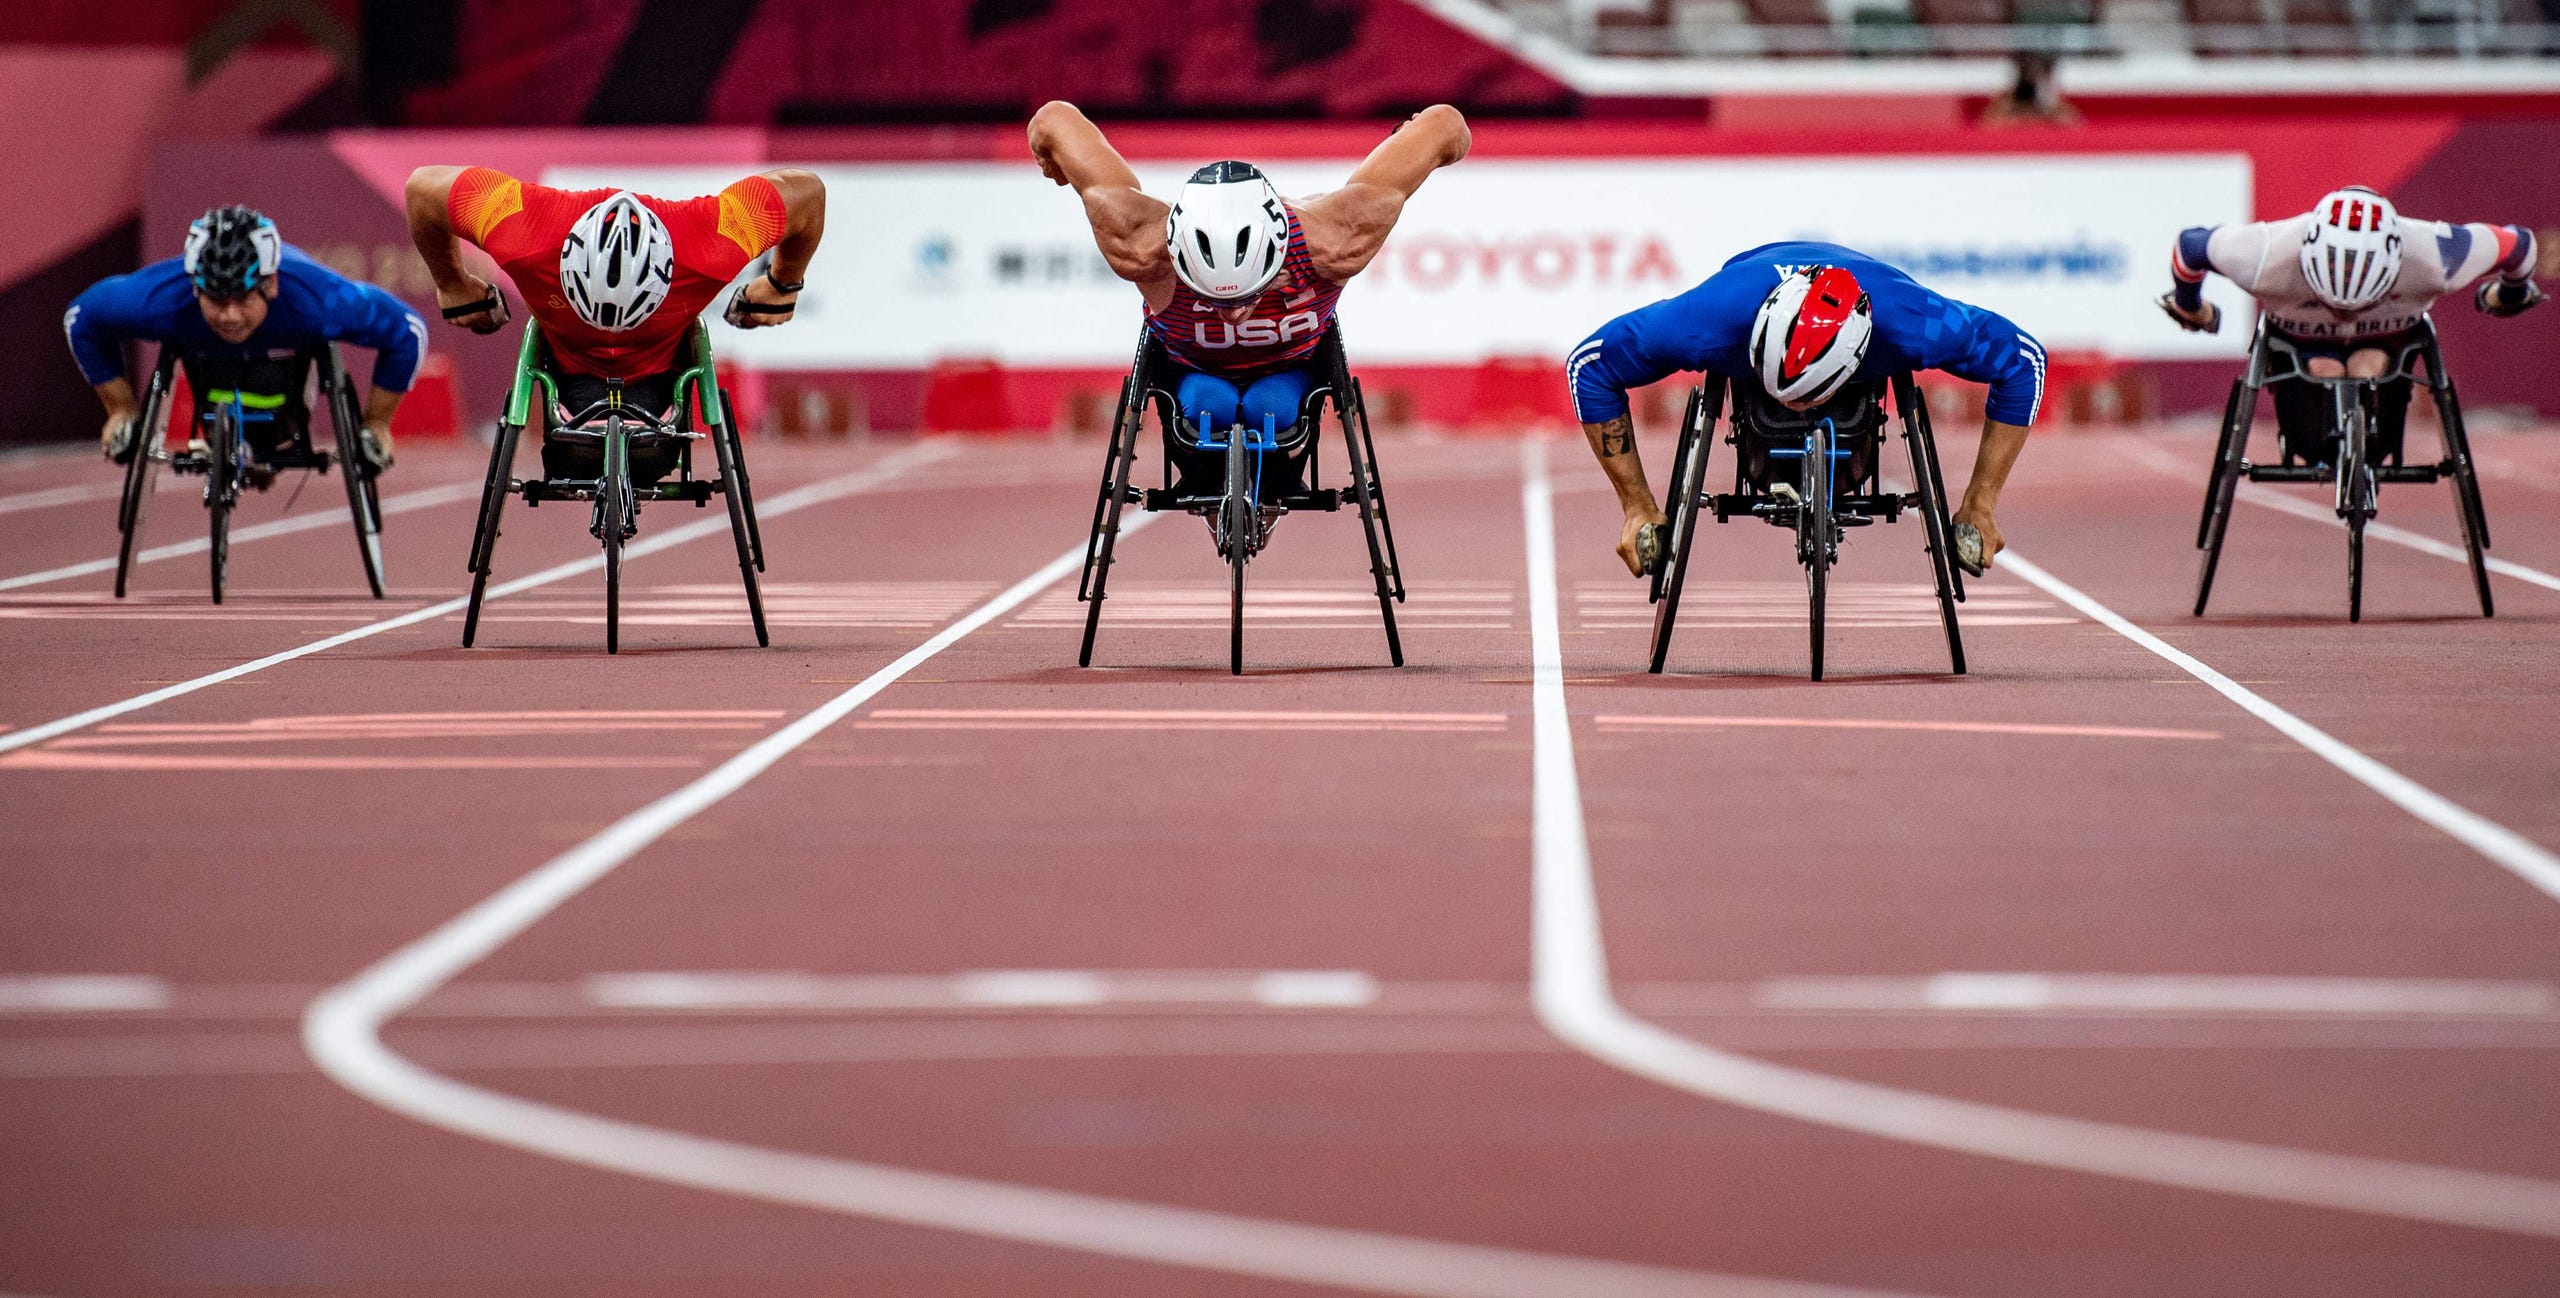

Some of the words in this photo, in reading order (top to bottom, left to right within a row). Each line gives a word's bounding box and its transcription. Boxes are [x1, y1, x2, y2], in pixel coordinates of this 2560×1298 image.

[1167, 203, 1183, 246] 5
[1262, 198, 1288, 241] 5
[262, 233, 277, 268] 7
[1215, 284, 1238, 292] GIRO
[1195, 311, 1319, 349] USA
[2355, 315, 2418, 335] BRITA
